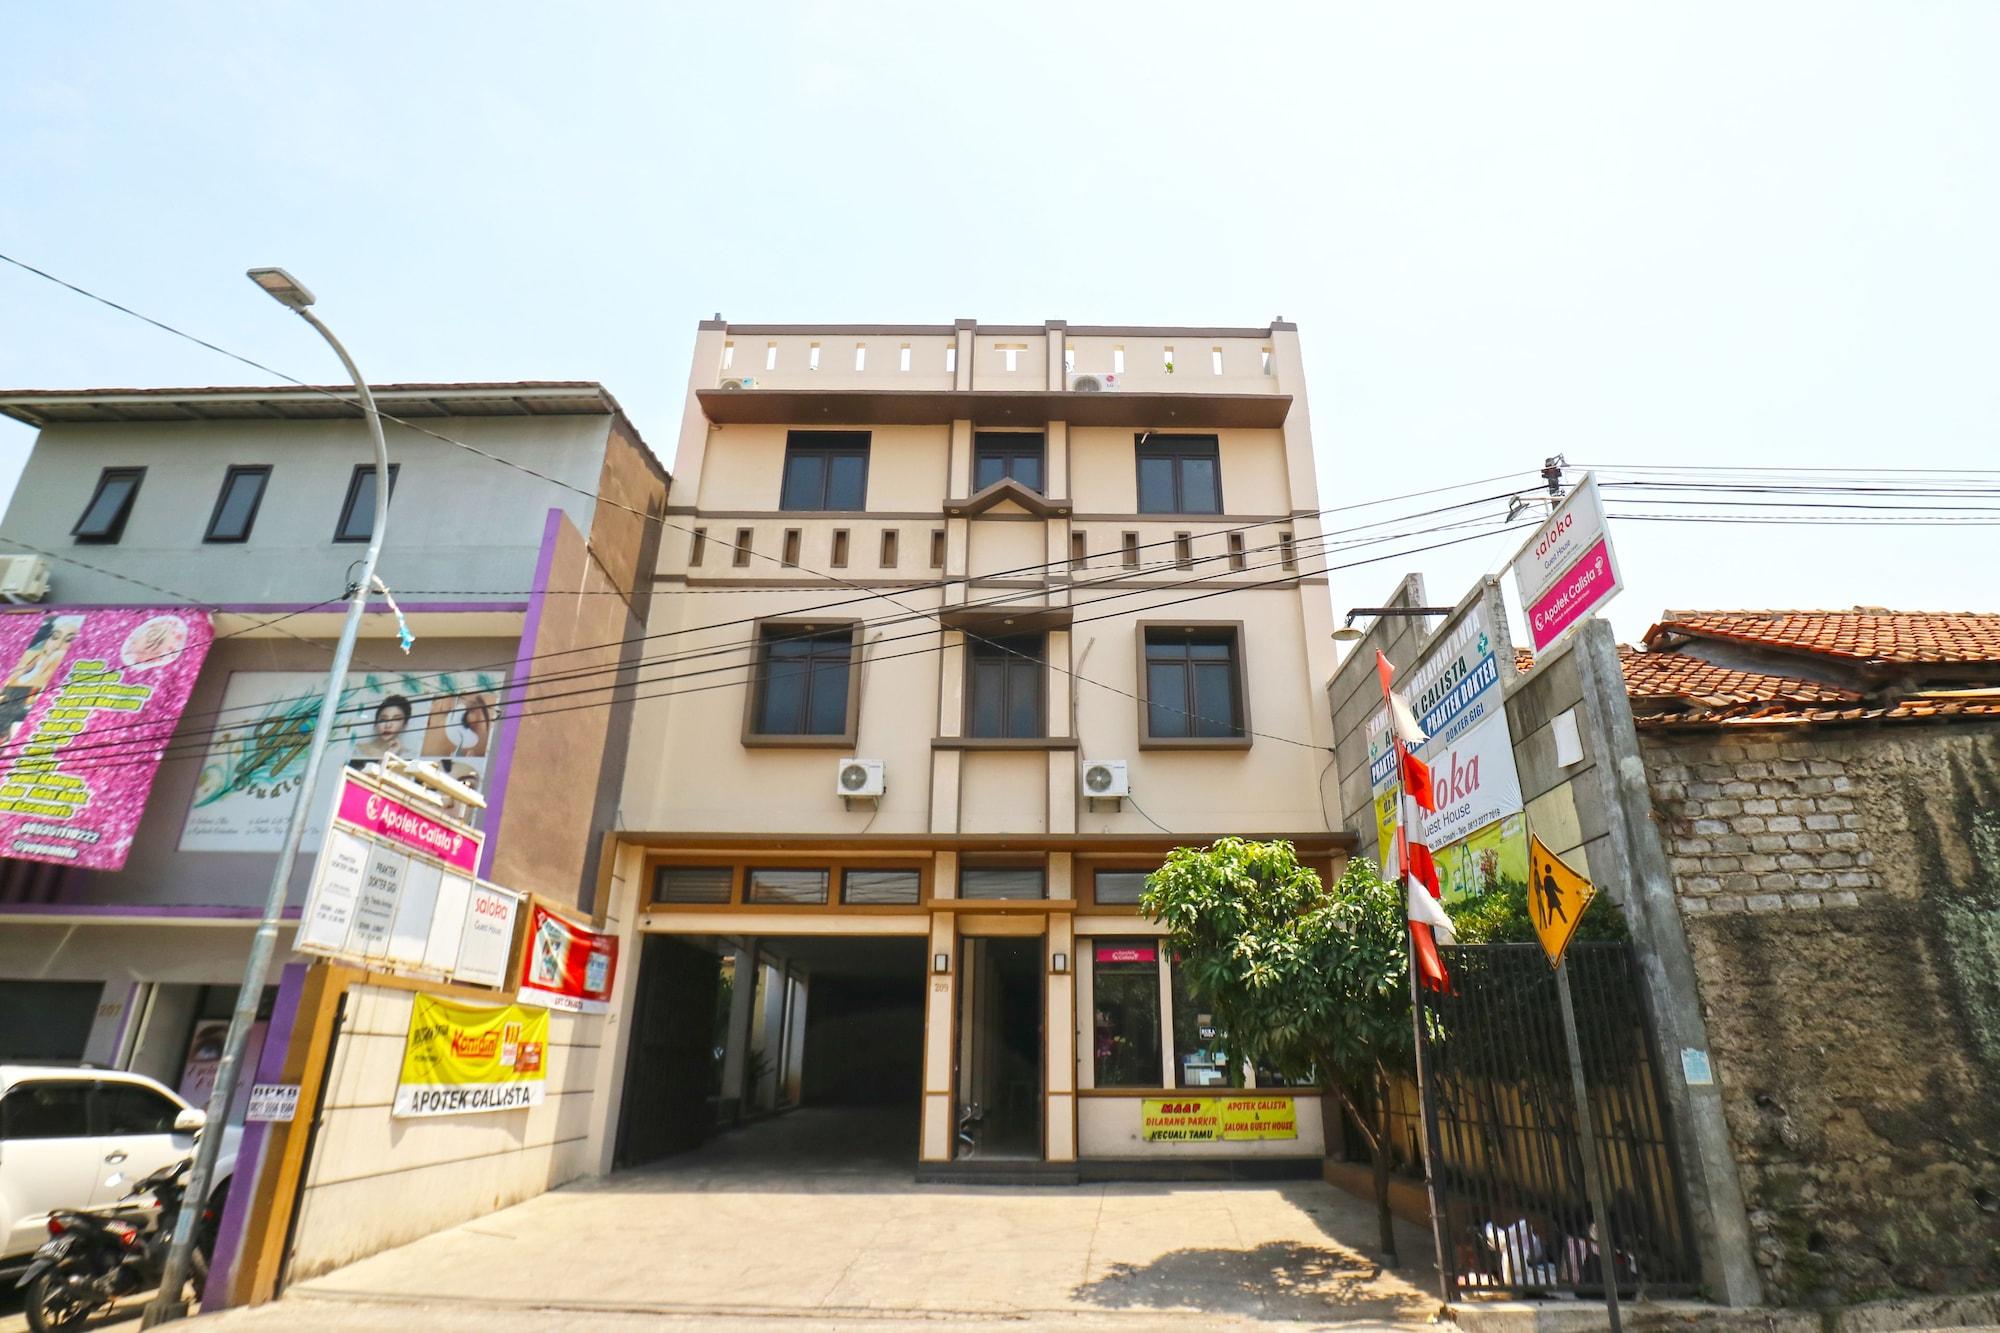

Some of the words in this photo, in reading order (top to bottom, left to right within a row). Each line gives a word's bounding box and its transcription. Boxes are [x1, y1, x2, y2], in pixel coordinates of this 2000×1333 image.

[1536, 513, 1573, 561] saloka
[1544, 592, 1570, 623] Apotek
[1568, 568, 1596, 599] Calista
[1411, 639, 1453, 697] MELAYANI
[1452, 609, 1480, 654] ANDA
[1420, 655, 1467, 714] CALISTA
[1426, 689, 1462, 736] PRAKTEK
[1460, 657, 1497, 705] DOKTER
[1445, 715, 1468, 743] DOKTER
[1469, 702, 1484, 723] GIGI
[379, 804, 418, 836] Apotek
[418, 822, 451, 850] Calista
[1424, 819, 1442, 838] uest
[1442, 802, 1471, 828] House
[411, 1089, 469, 1113] APOTEK
[469, 1085, 530, 1109] CALLISTA
[1161, 1103, 1201, 1113] MAAF
[1228, 1101, 1256, 1111] APOTEK
[1257, 1100, 1287, 1110] CALISTA
[1146, 1116, 1185, 1126] DILARANG
[1188, 1116, 1217, 1126] PARKIR
[1151, 1130, 1187, 1139] KECUALI
[1188, 1130, 1213, 1138] TAMU
[1225, 1122, 1249, 1132] SALOKA
[1250, 1121, 1271, 1130] GUEST
[1271, 1121, 1294, 1130] HOUSE
